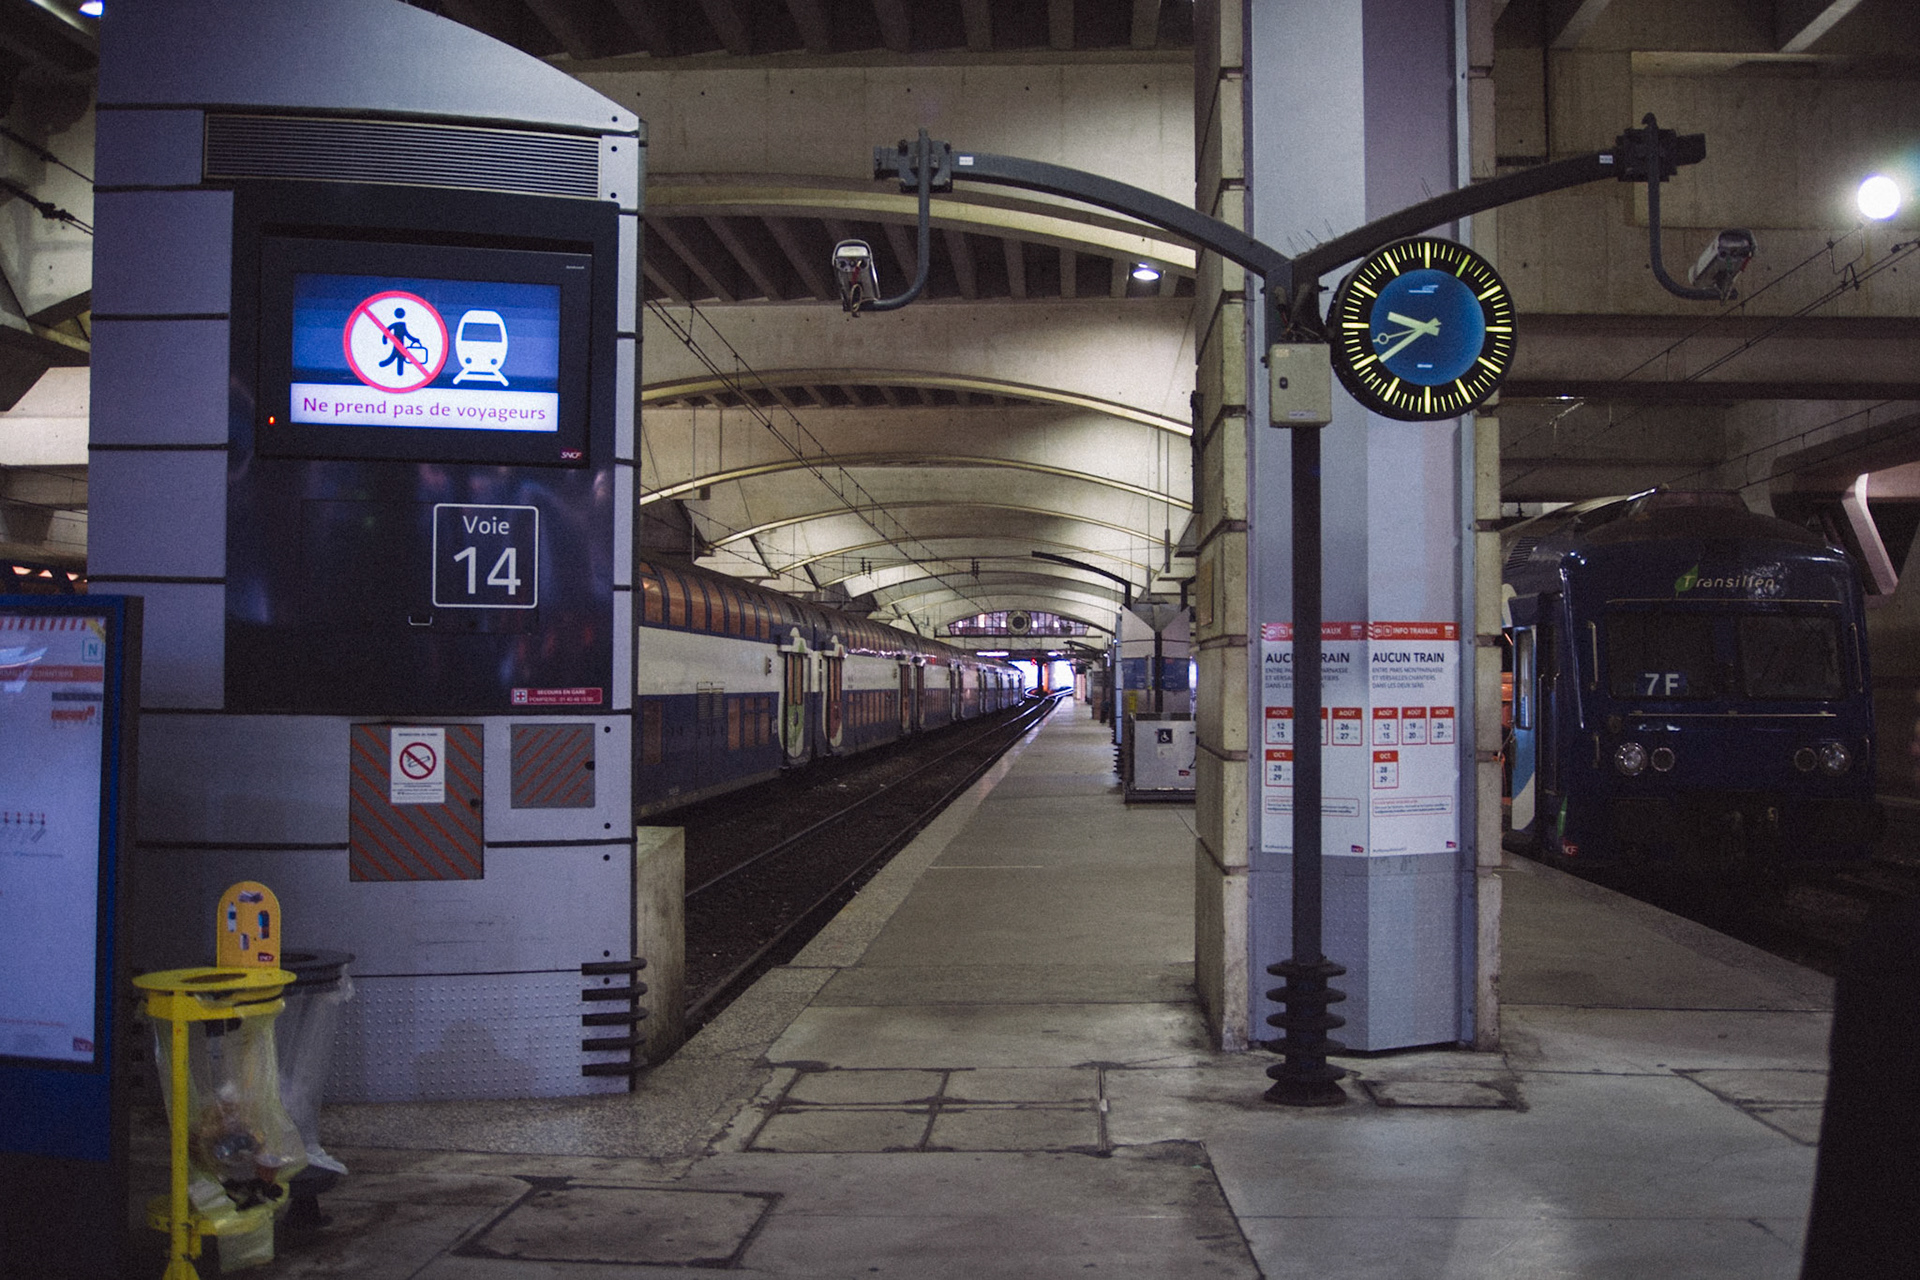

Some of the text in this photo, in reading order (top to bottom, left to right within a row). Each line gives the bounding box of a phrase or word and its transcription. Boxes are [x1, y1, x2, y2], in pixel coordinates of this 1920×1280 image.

[303, 397, 547, 422] Ne prend pas de voyageurs
[560, 451, 583, 459] SNCF
[462, 515, 510, 535] Voie
[453, 546, 522, 595] 14
[1683, 574, 1776, 589] Transilien
[1392, 627, 1409, 635] INFO
[1409, 627, 1439, 635] TRAVAUX
[88, 643, 98, 656] N
[1321, 652, 1350, 664] RAIN
[1372, 652, 1445, 663] AUCUN TRAIN
[1276, 722, 1286, 730] 12
[1339, 723, 1350, 731] 26
[1382, 723, 1391, 731] 12
[1276, 731, 1286, 739] 15
[1340, 732, 1350, 740] 27
[1436, 731, 1445, 739] 27
[1273, 764, 1282, 772] 28
[1380, 766, 1388, 774] 28
